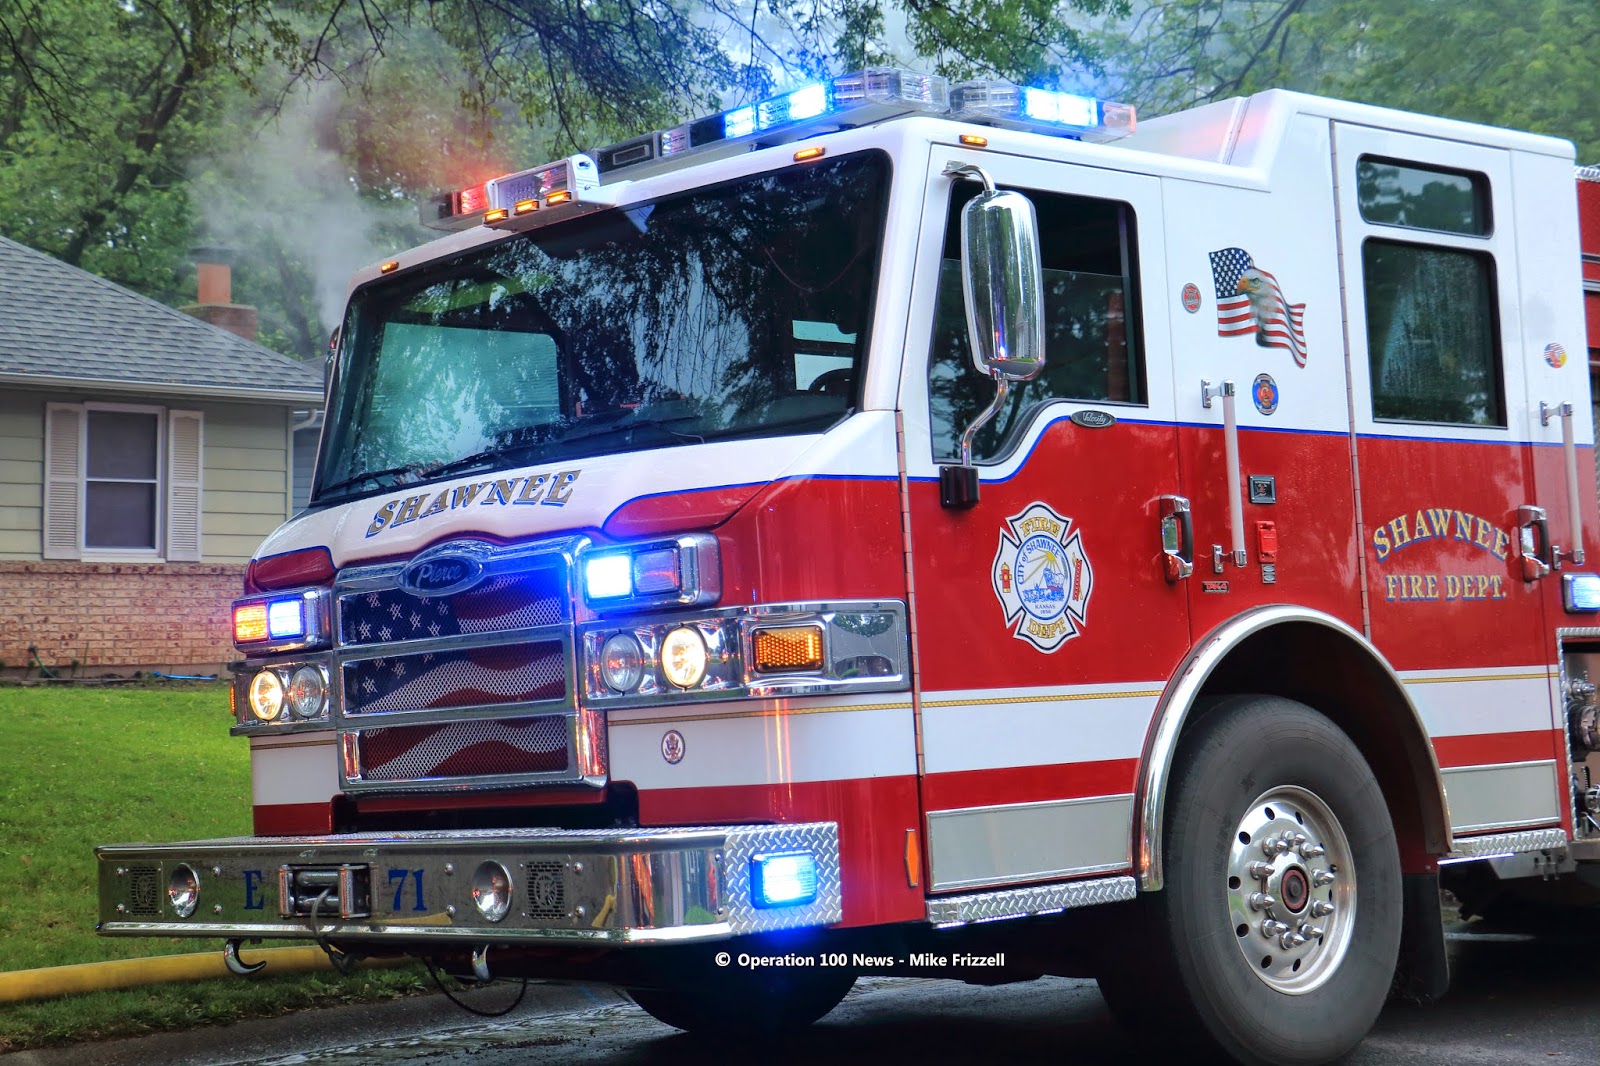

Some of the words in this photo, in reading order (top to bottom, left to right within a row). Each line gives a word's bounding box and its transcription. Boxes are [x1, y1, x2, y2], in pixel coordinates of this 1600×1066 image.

[1082, 412, 1107, 425] Velocity
[365, 470, 581, 538] SHAWNEE
[1019, 516, 1061, 538] FIRE
[1373, 508, 1510, 564] SHAWNEE
[415, 563, 463, 588] Pierce
[1017, 563, 1025, 585] CITY
[1025, 538, 1062, 559] SHAWNEE
[1385, 574, 1440, 602] FIRE
[1445, 574, 1507, 602] DEPT.
[1027, 617, 1067, 639] DEPT
[243, 869, 264, 910] E
[387, 869, 428, 911] 71
